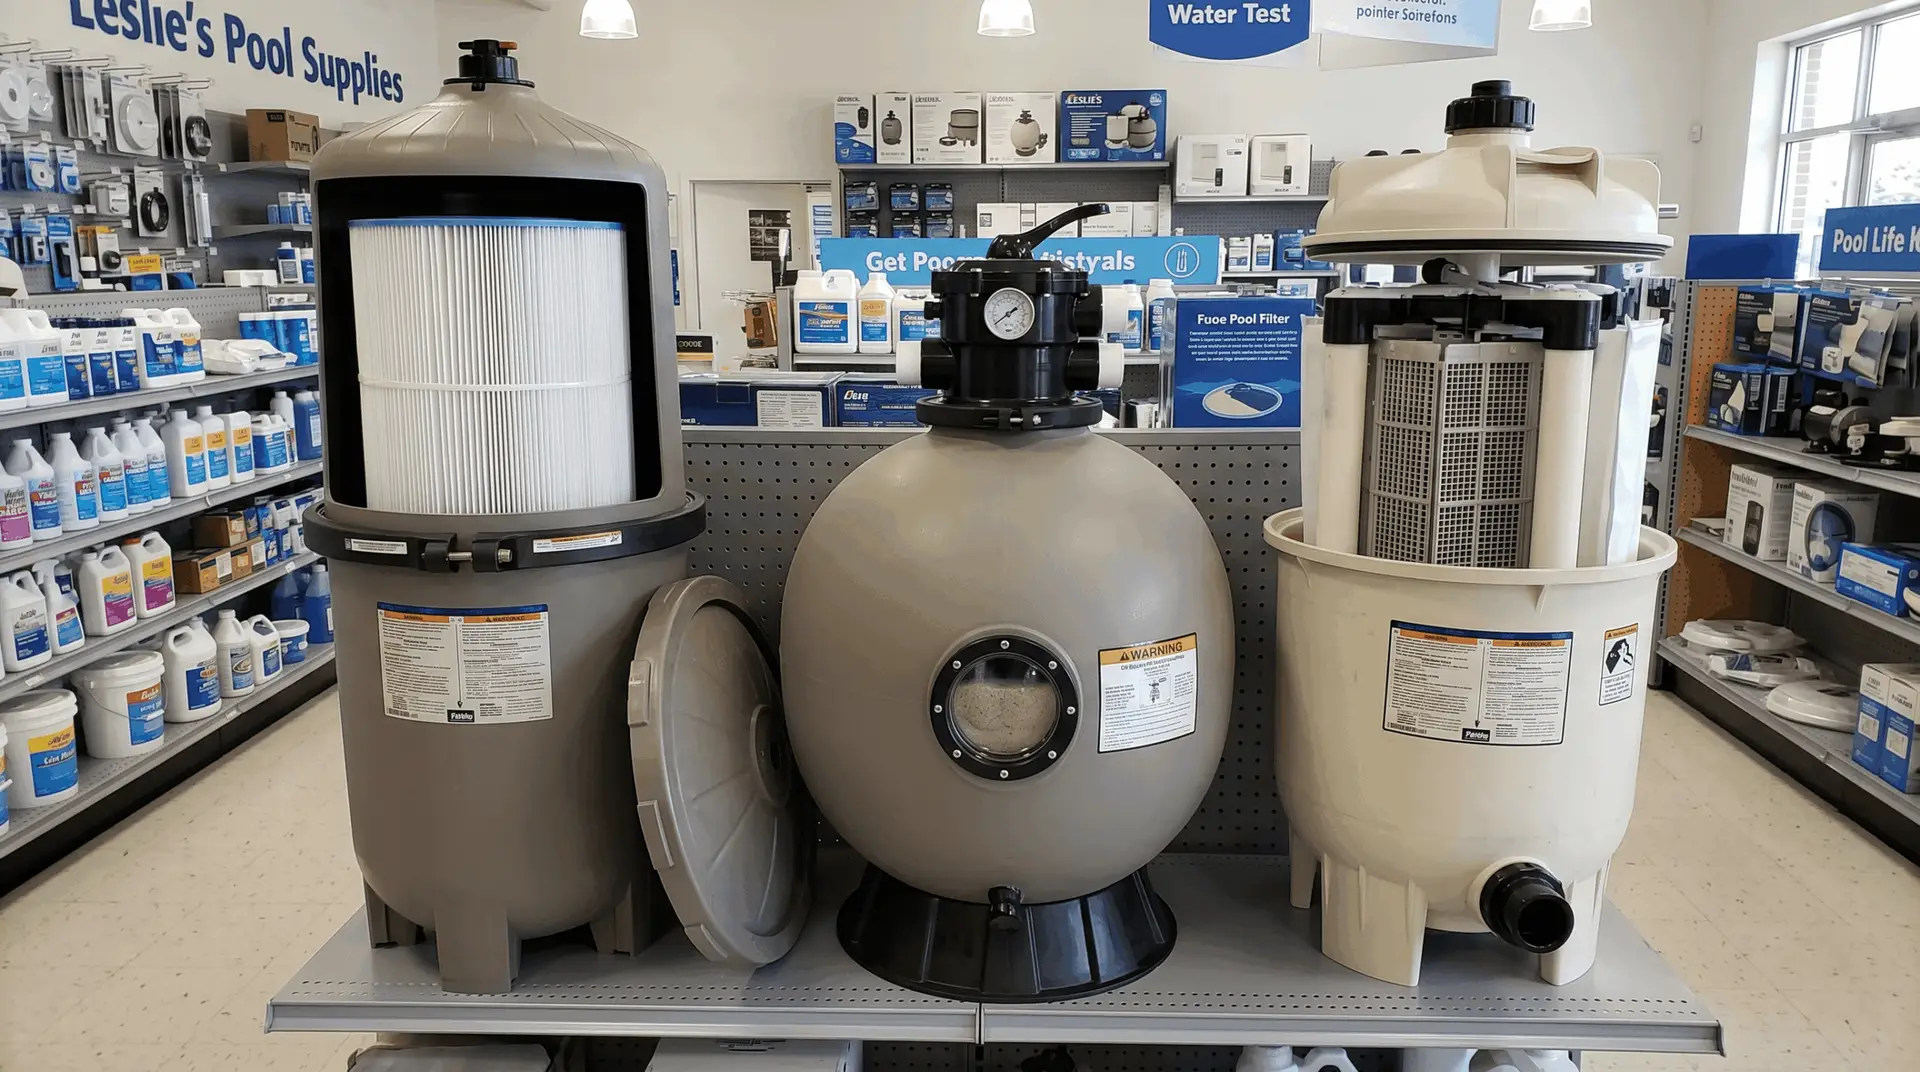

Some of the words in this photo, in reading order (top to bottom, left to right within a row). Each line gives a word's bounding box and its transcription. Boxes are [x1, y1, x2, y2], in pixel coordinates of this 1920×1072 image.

[1167, 4, 1237, 24] Water
[1243, 3, 1291, 23] Test
[1356, 6, 1399, 19] pointer
[70, 0, 215, 58] Leslie's
[223, 12, 294, 78] Pool
[301, 36, 404, 106] Supplies
[1066, 94, 1103, 105] LESLIE'S
[1832, 226, 1869, 253] Pool
[1872, 225, 1905, 253] Life
[866, 251, 907, 272] Get
[1229, 313, 1257, 325] Pool
[1259, 313, 1291, 325] Filter
[1130, 641, 1183, 660] WARNING
